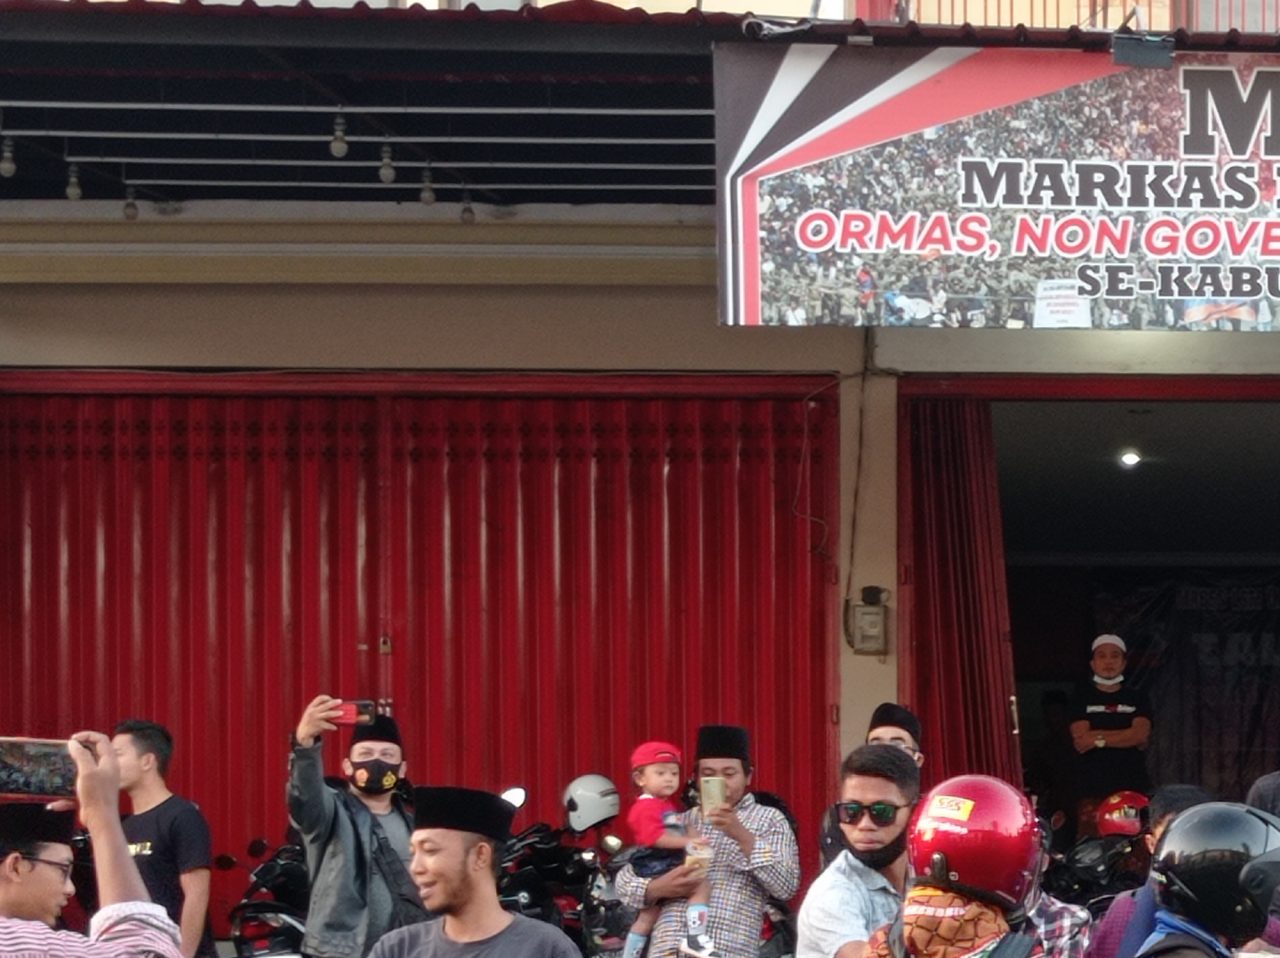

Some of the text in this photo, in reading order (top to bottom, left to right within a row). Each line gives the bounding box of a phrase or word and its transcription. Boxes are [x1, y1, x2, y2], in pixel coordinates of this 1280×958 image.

[960, 159, 1258, 210] MARKAS
[797, 211, 1000, 259] ORMAS,
[1013, 216, 1132, 258] NON
